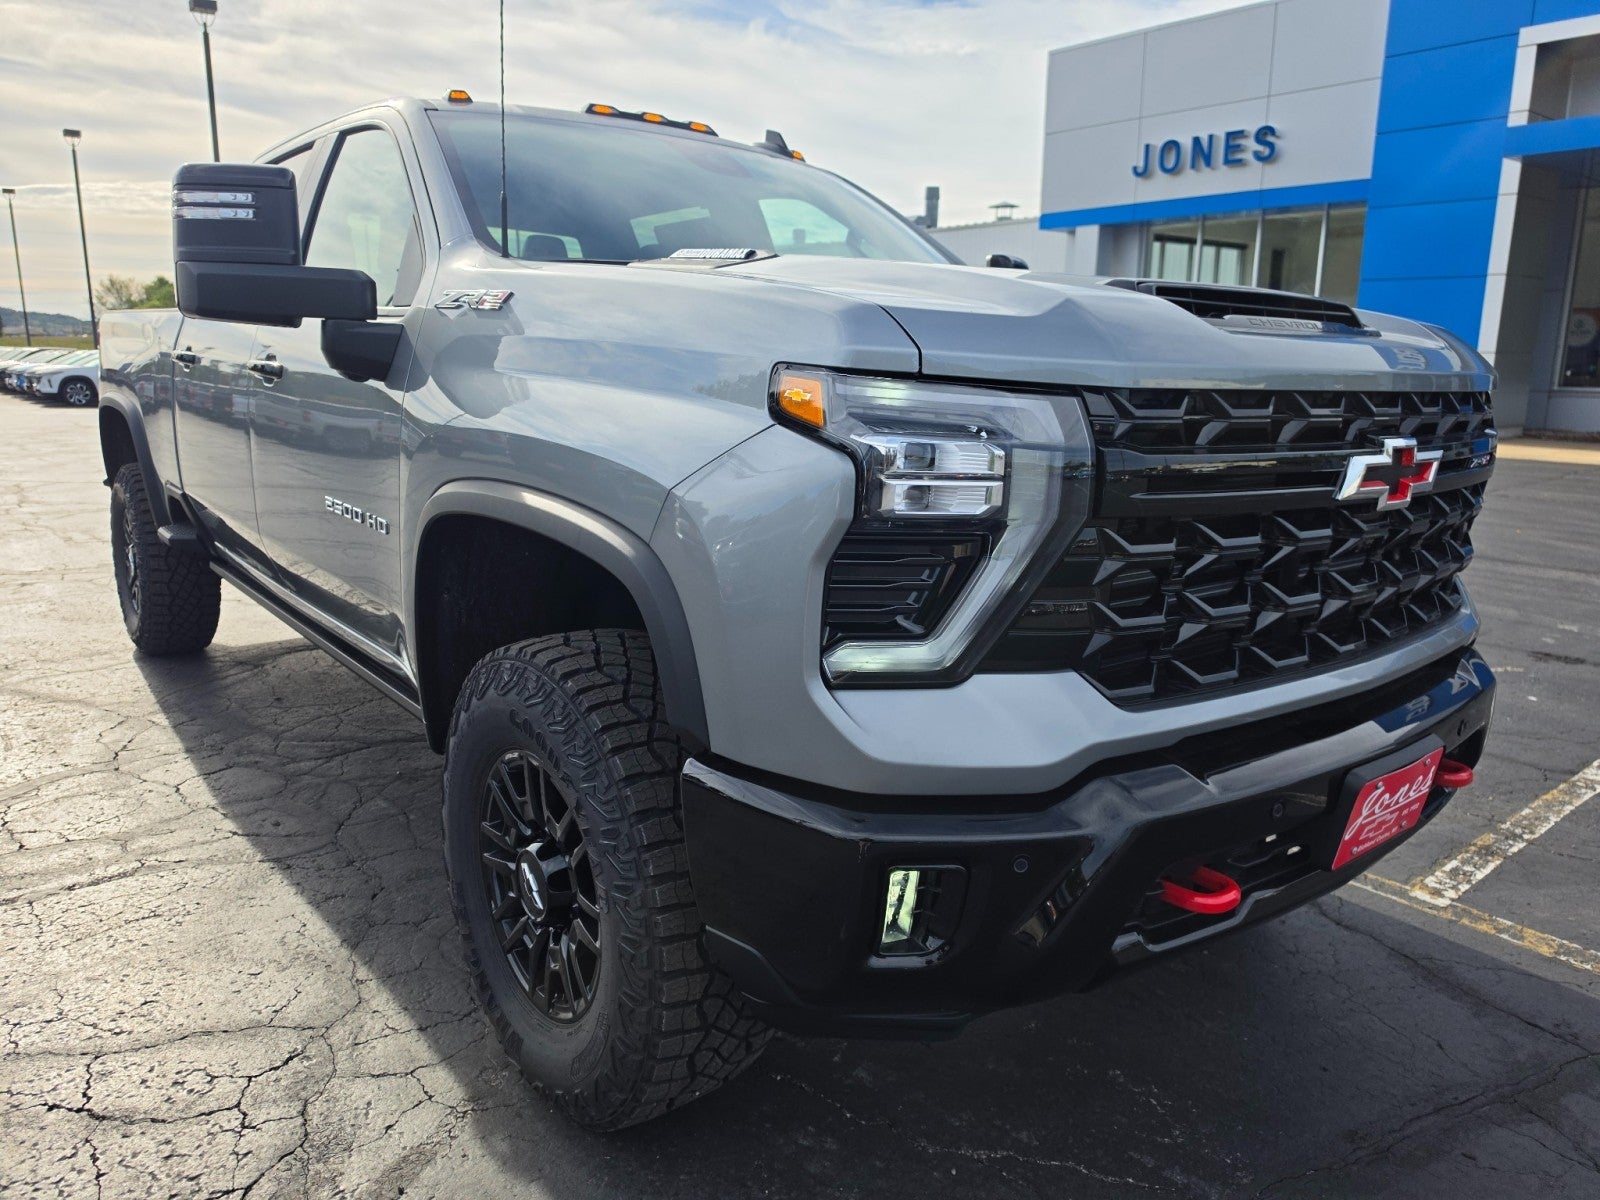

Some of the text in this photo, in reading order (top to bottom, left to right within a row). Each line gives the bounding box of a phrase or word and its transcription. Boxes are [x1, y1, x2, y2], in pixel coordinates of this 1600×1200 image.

[1131, 124, 1280, 179] JONES
[434, 289, 514, 310] ZR2
[1246, 317, 1341, 333] CHEVROL
[324, 495, 390, 535] 2500 HD
[1344, 765, 1436, 841] Jones
